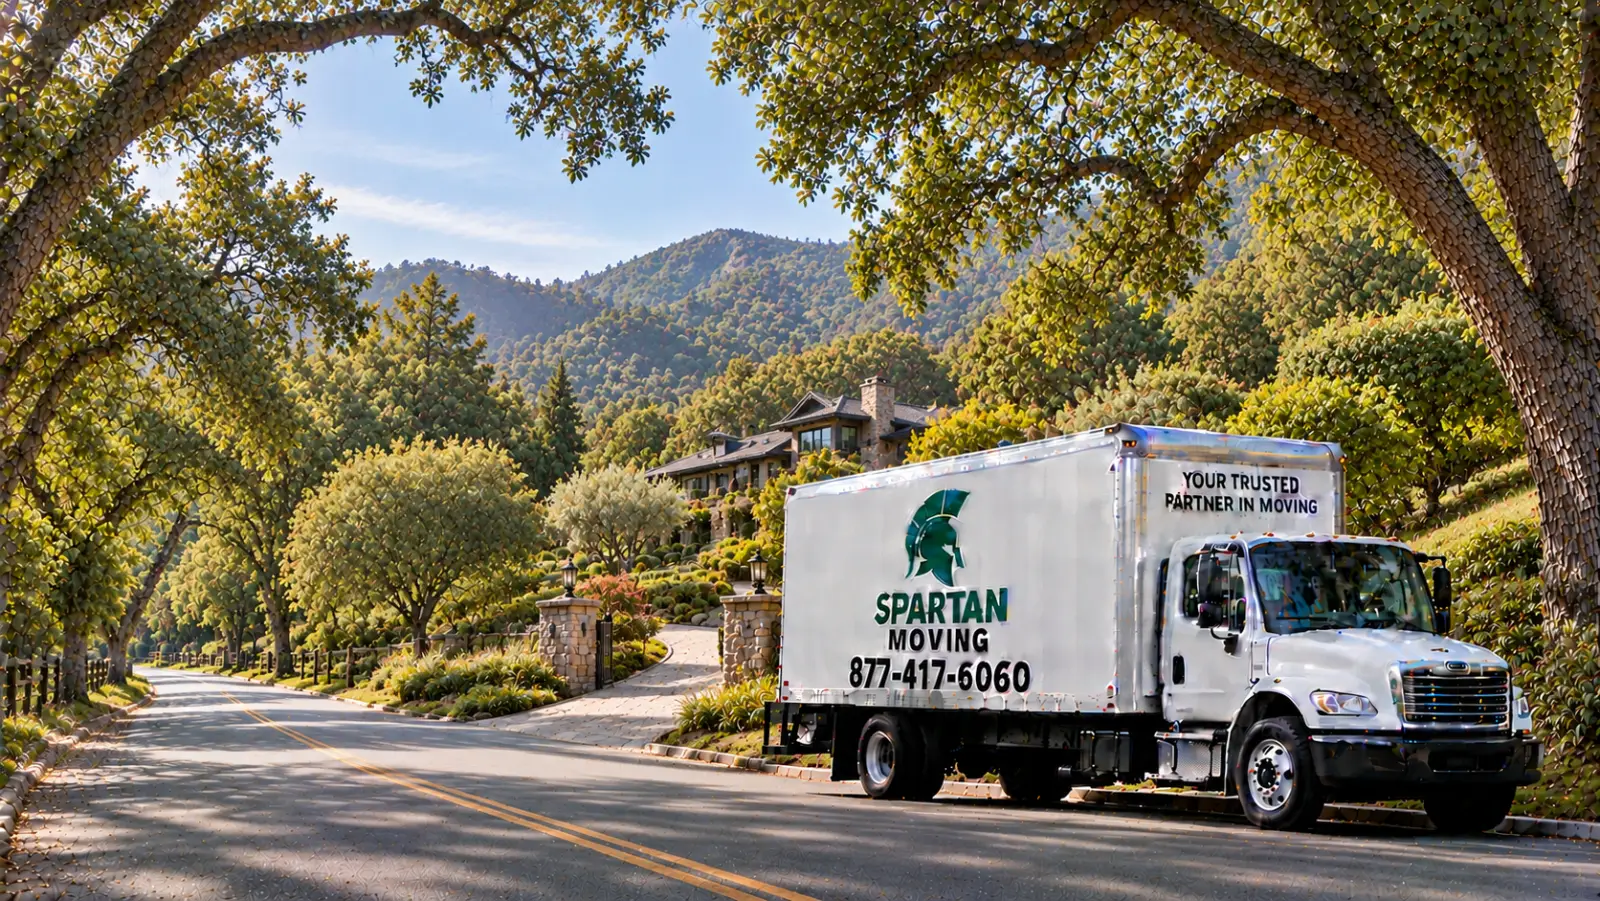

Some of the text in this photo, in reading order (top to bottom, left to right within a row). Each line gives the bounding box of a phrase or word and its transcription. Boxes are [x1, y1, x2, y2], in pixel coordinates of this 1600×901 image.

[1183, 472, 1299, 494] YOUR TRUSTED
[1165, 493, 1318, 514] PARTNER IN MOVING
[874, 587, 1008, 625] SPARTAN
[888, 628, 989, 652] MOVING
[849, 656, 1031, 693] 877-417-6060
